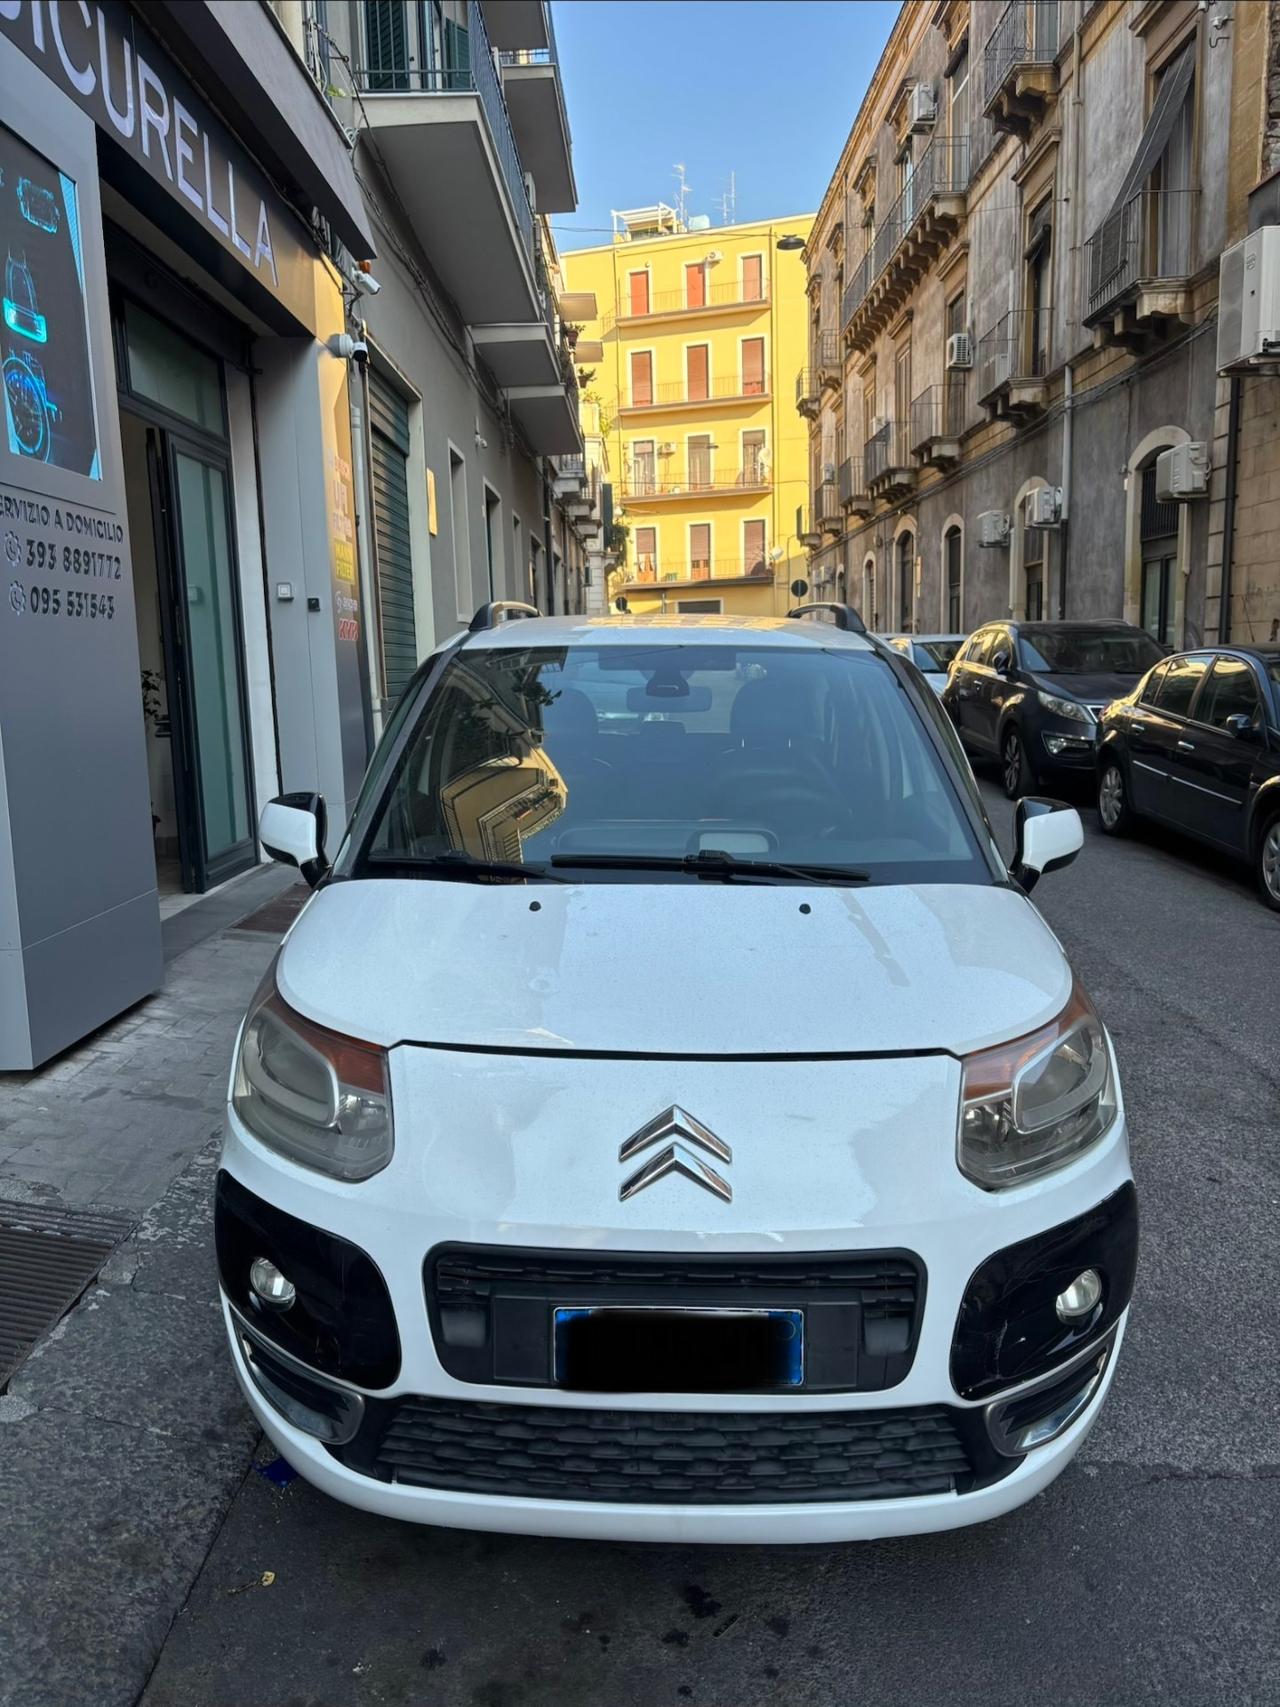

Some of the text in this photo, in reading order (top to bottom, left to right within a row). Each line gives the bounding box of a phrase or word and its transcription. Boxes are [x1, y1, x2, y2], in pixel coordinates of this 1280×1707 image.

[0, 0, 279, 287] CURELLA
[55, 509, 64, 530] A
[66, 511, 124, 543] DOMICILIO
[26, 538, 122, 580] 393 8891772
[30, 586, 115, 620] 095 531543
